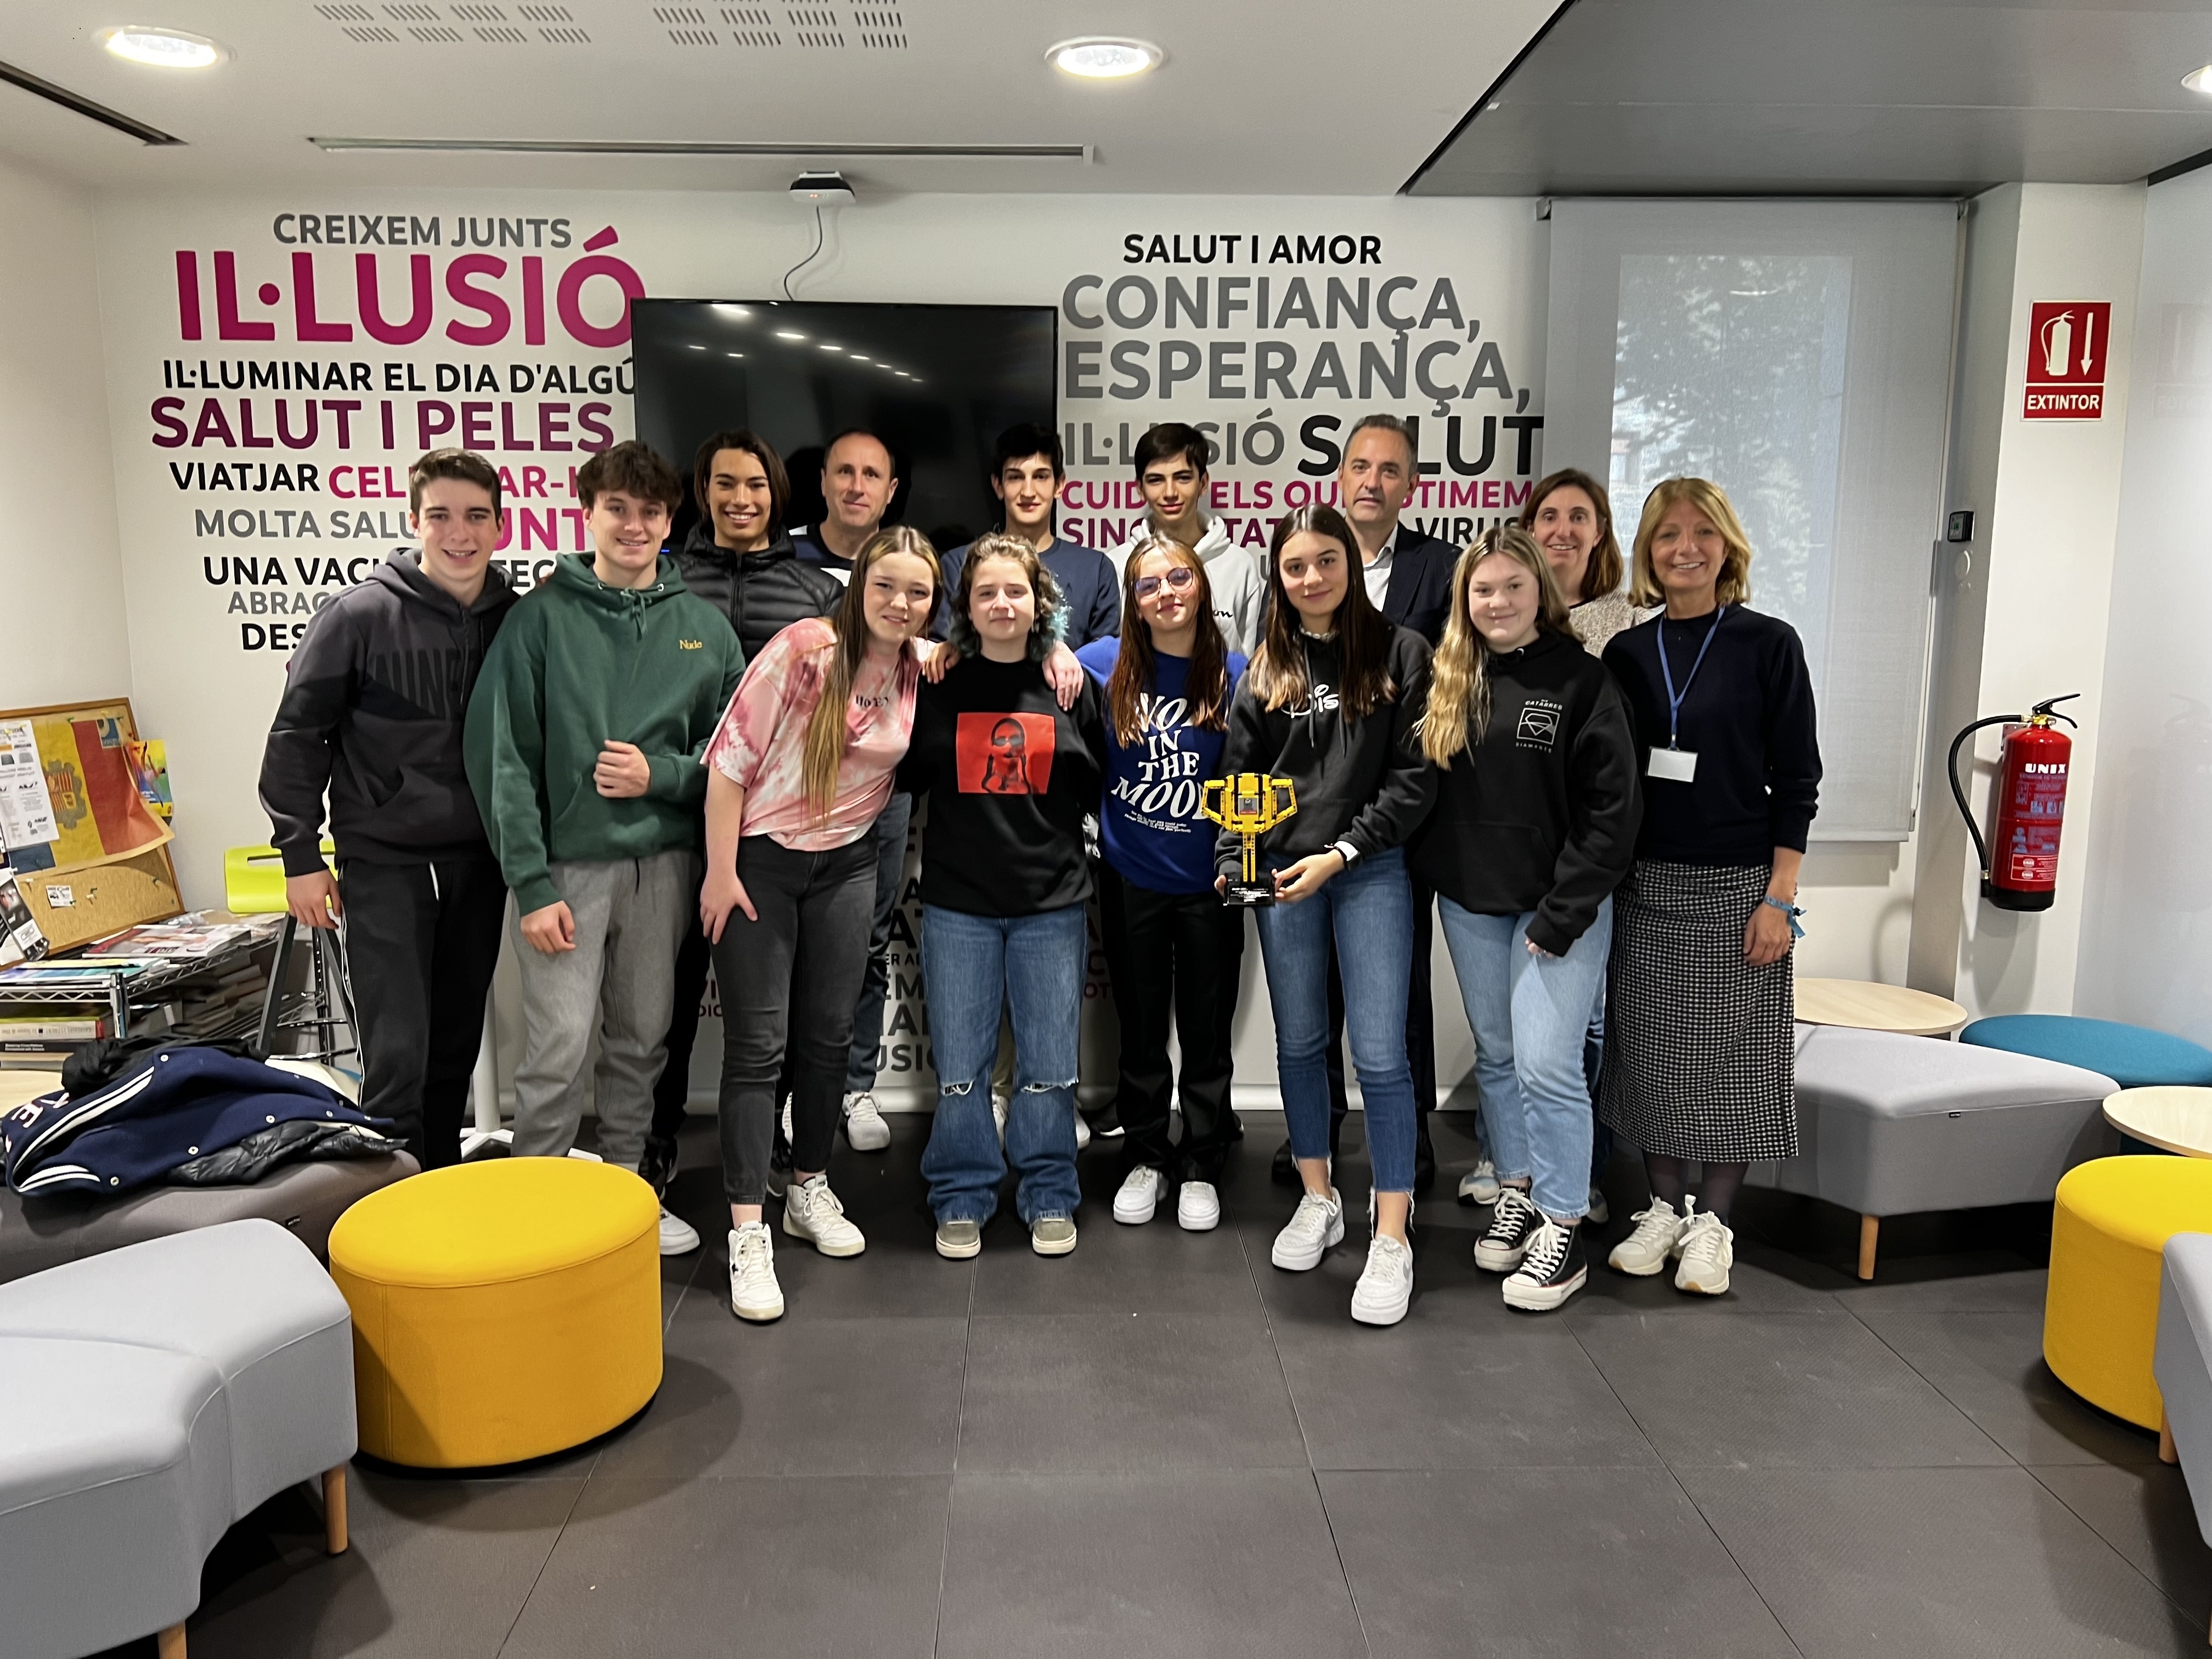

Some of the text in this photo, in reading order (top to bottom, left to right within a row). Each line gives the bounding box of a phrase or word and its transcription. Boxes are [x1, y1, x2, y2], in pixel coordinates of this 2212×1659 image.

[274, 213, 572, 249] CREIXEM JUNTS
[1124, 234, 1381, 264] SALUT I AMOR
[1063, 274, 1481, 345] CONFIANÇA,
[384, 363, 426, 392] EL
[436, 364, 500, 393] DIA
[510, 357, 635, 396] D'ALGÚ
[1065, 339, 1531, 417] ESPERANÇA,
[2027, 394, 2100, 410] EXTINTOR
[151, 397, 613, 453] SALUT I PELES
[1065, 408, 1544, 476] IL·LSIÓ SLUT
[170, 462, 320, 492] VIATJAR
[1211, 481, 1273, 510] ELS
[195, 509, 321, 538] MOLTA
[330, 510, 416, 539] SALU
[204, 556, 287, 586] UNA
[679, 639, 703, 650] Nude
[1148, 729, 1182, 760] IN
[1138, 751, 1200, 782] THE
[2024, 763, 2066, 774] UNIX
